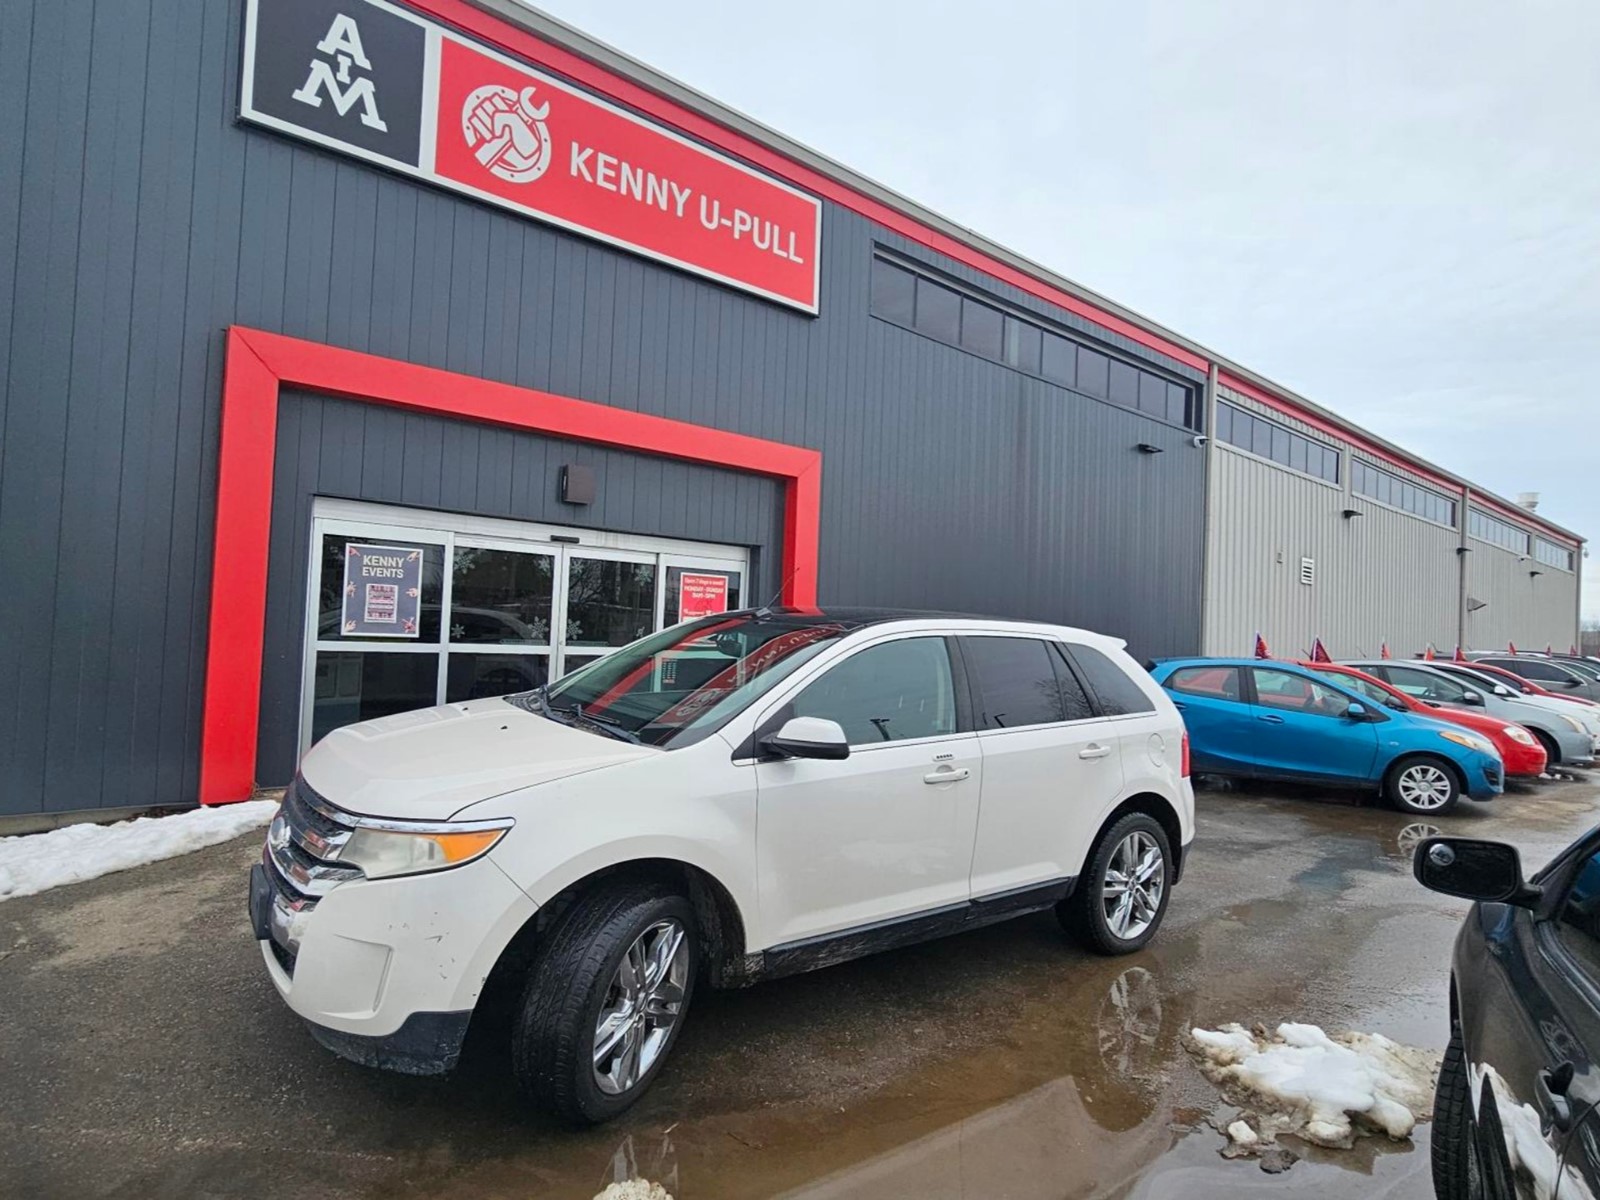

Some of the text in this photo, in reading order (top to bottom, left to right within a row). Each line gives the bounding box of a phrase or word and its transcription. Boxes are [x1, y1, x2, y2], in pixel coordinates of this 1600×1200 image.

[570, 141, 804, 264] KENNY U-PULL
[363, 555, 404, 567] KENNY
[362, 567, 404, 578] EVENTS
